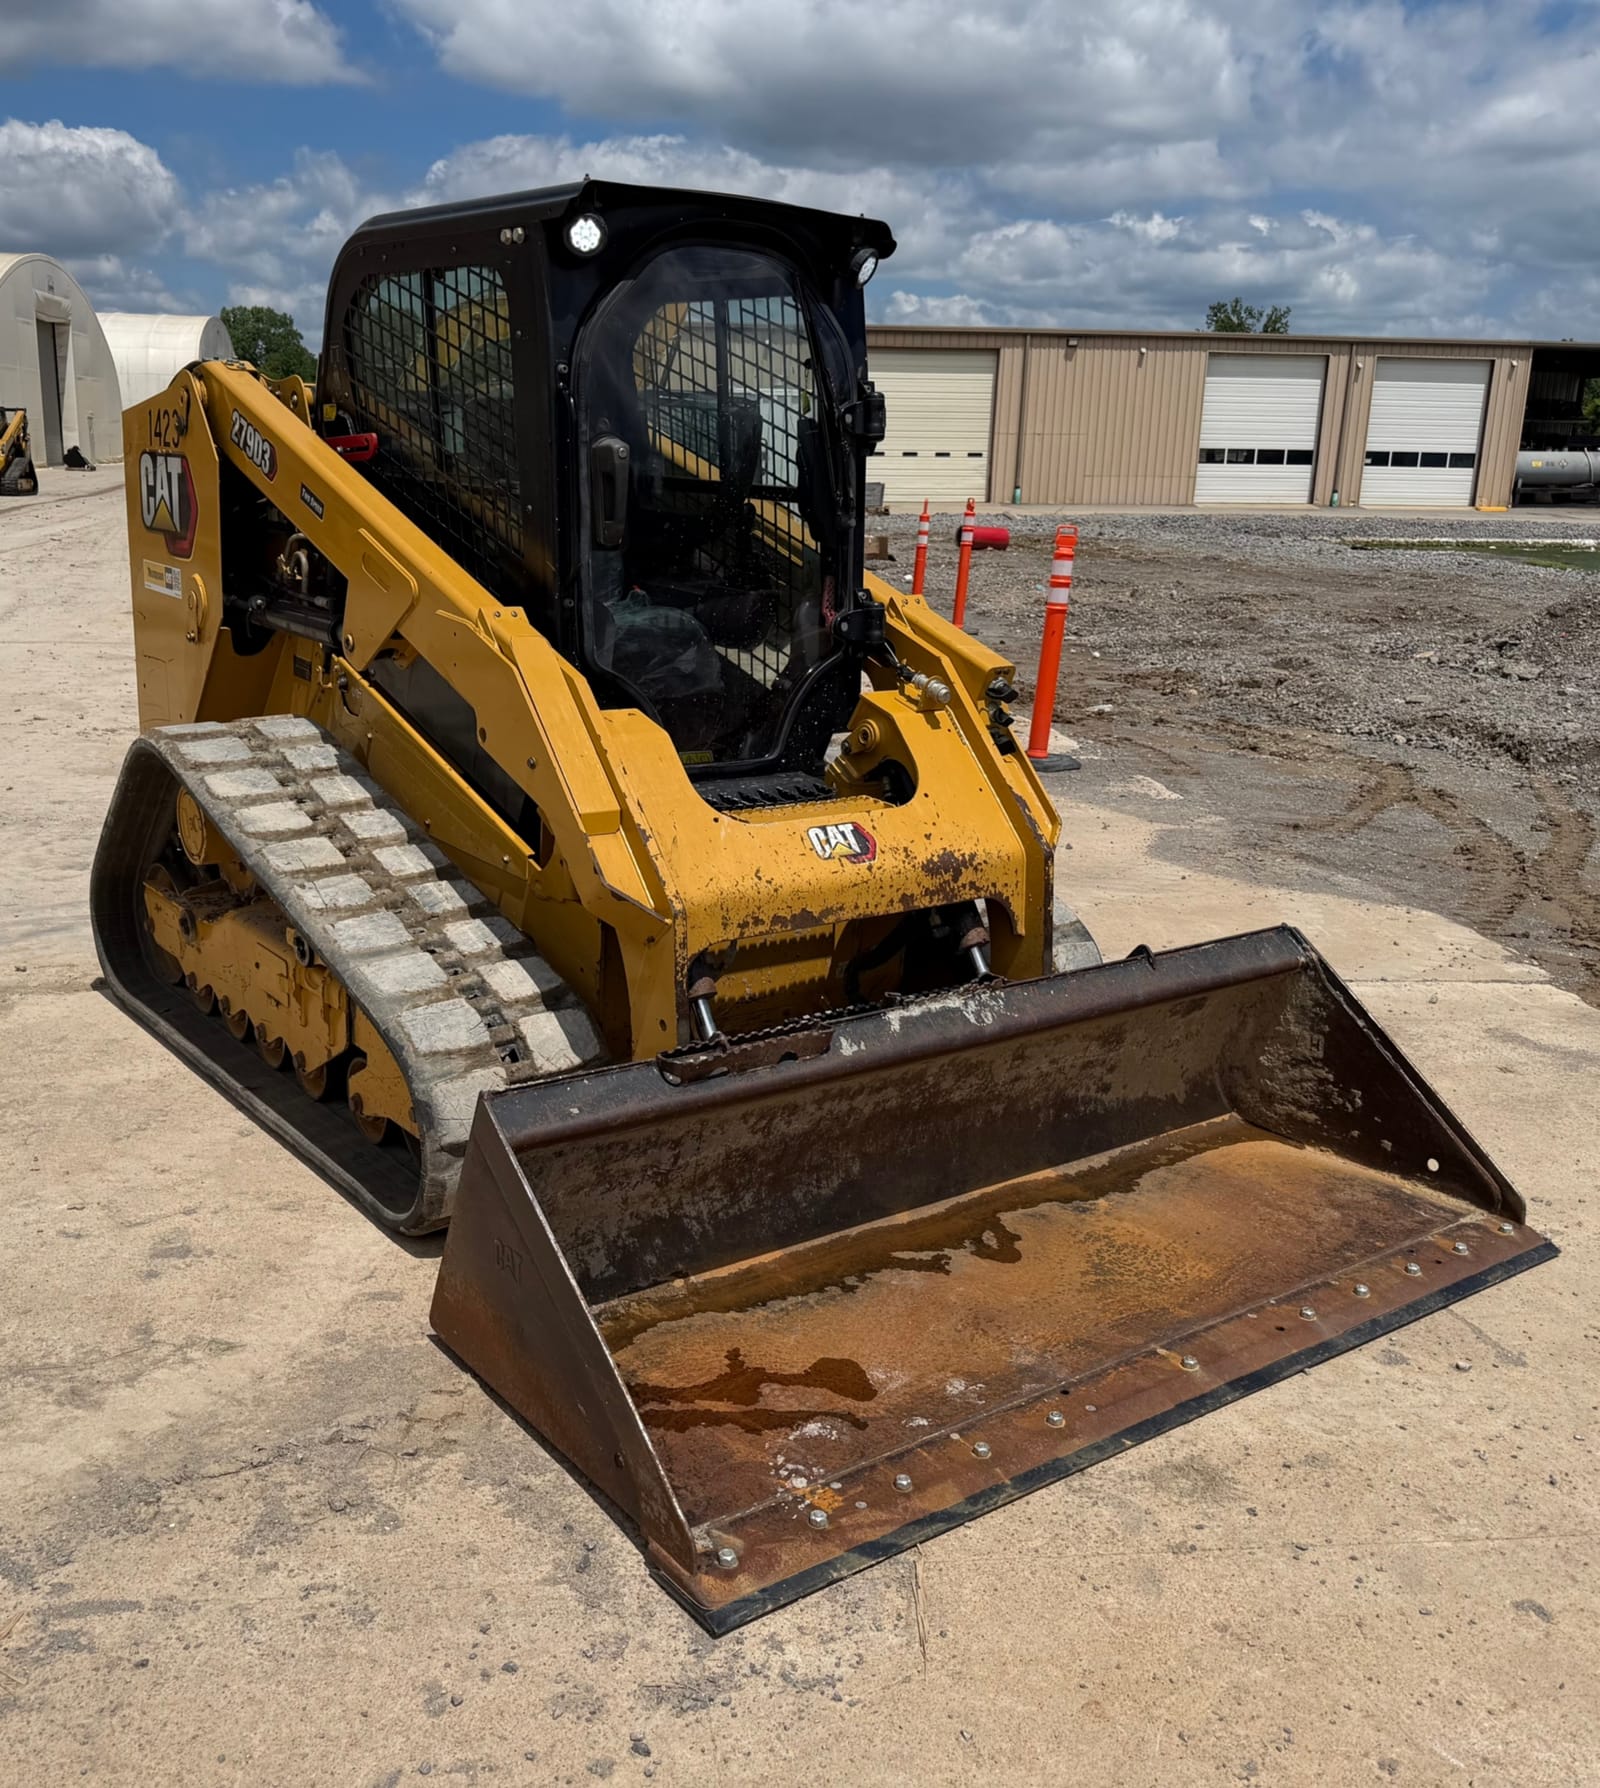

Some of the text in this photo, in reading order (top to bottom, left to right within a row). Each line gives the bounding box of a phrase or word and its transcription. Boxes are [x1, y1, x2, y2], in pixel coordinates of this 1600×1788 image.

[231, 410, 271, 474] 279D3
[140, 453, 183, 532] CAT
[808, 823, 862, 859] CAT
